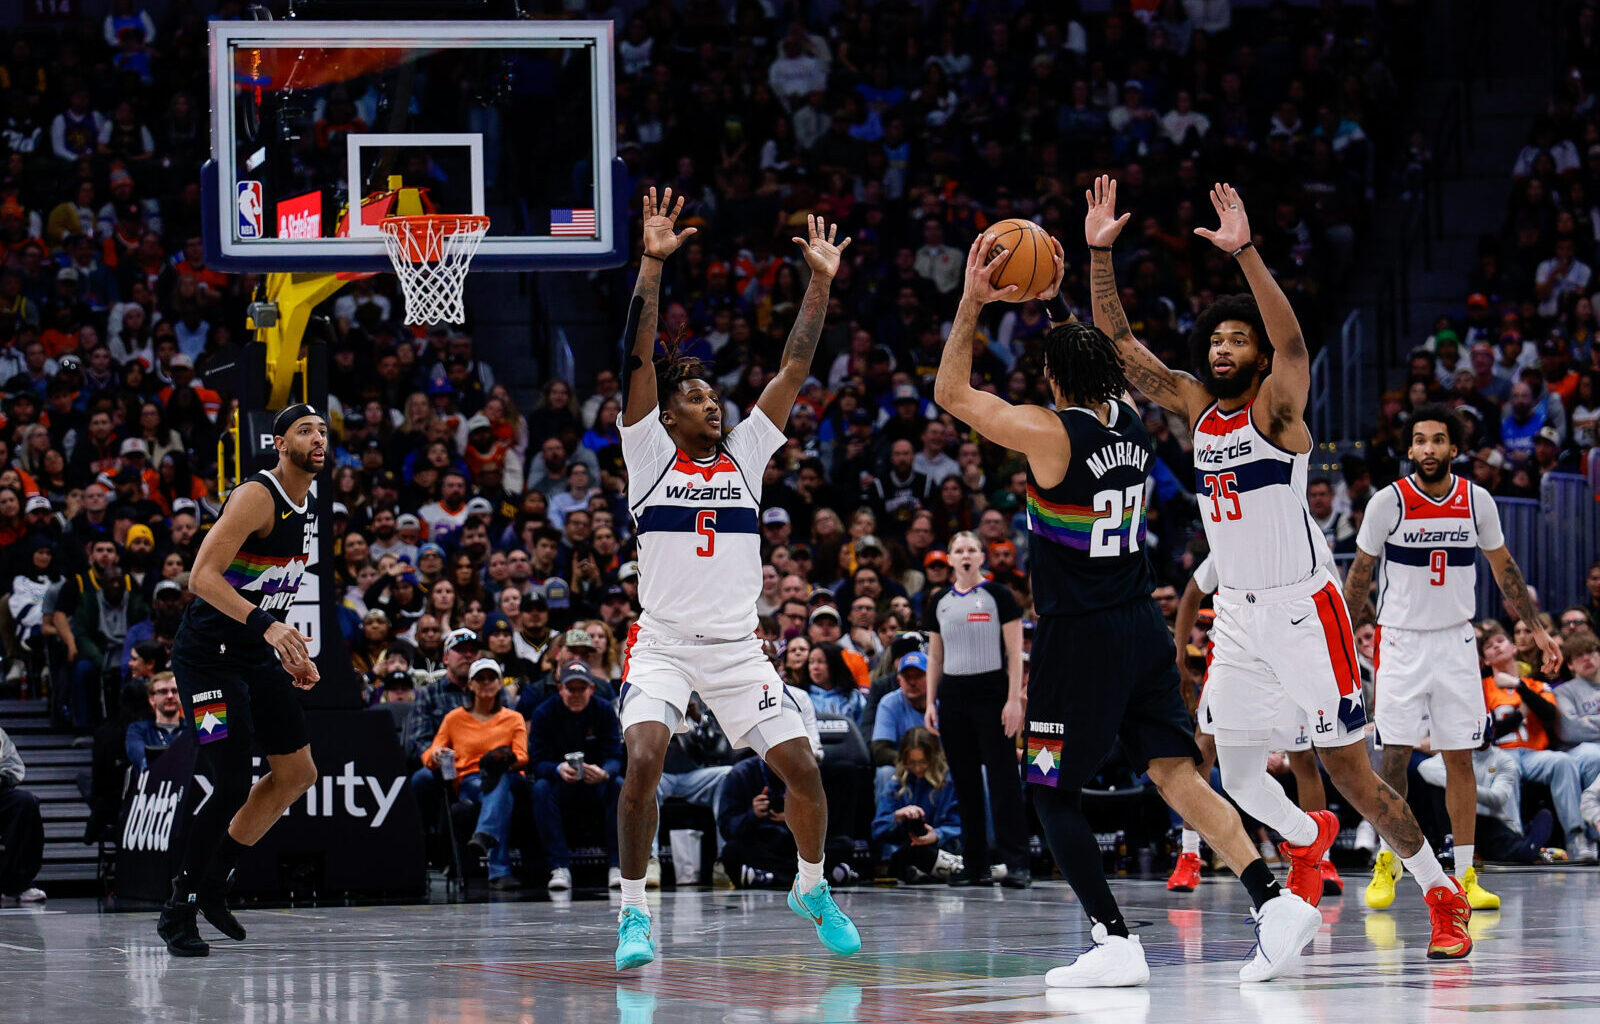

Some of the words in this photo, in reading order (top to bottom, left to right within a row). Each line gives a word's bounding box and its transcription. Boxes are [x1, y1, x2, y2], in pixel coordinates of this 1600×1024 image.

[1085, 441, 1149, 479] MURRAY
[666, 480, 742, 500] wizards
[1204, 473, 1242, 522] 35
[696, 510, 717, 557] 5
[1089, 482, 1145, 558] 27
[1403, 525, 1469, 543] wizards
[1429, 550, 1446, 586] 9
[192, 690, 223, 704] NUGGETS
[1029, 721, 1064, 734] NUGGETS
[122, 769, 178, 852] ibotta
